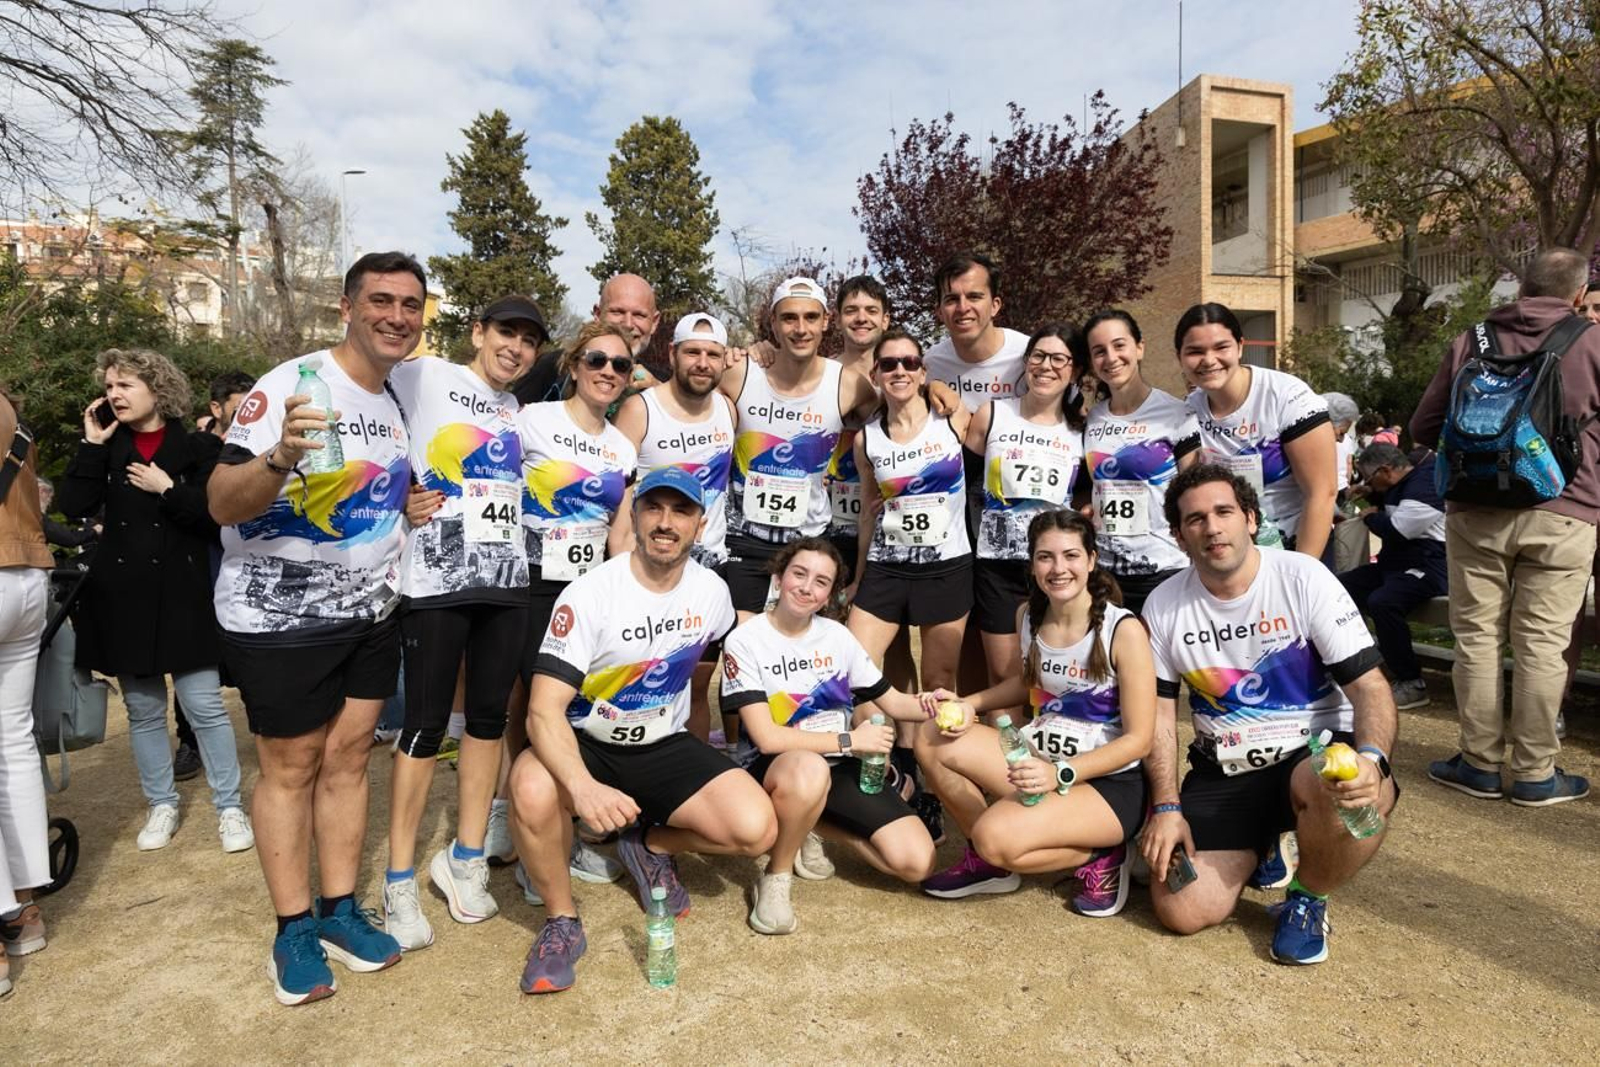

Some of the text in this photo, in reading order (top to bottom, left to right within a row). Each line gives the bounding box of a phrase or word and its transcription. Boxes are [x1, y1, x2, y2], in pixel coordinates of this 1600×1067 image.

[946, 375, 1011, 399] alderón
[748, 402, 823, 424] calderón
[657, 426, 729, 453] calderón
[1088, 420, 1147, 438] calderón
[554, 432, 617, 461] calderón
[999, 430, 1070, 451] calderón
[874, 441, 942, 469] calderón
[757, 463, 806, 477] entrénate
[1014, 465, 1059, 486] 736
[756, 492, 797, 513] 154
[481, 502, 517, 525] 448
[902, 513, 930, 531] 58
[567, 543, 594, 564] 69
[622, 608, 702, 646] calderón
[1183, 610, 1288, 652] calderón
[1041, 659, 1089, 680] derón
[610, 726, 645, 742] 59
[1032, 730, 1079, 757] 155
